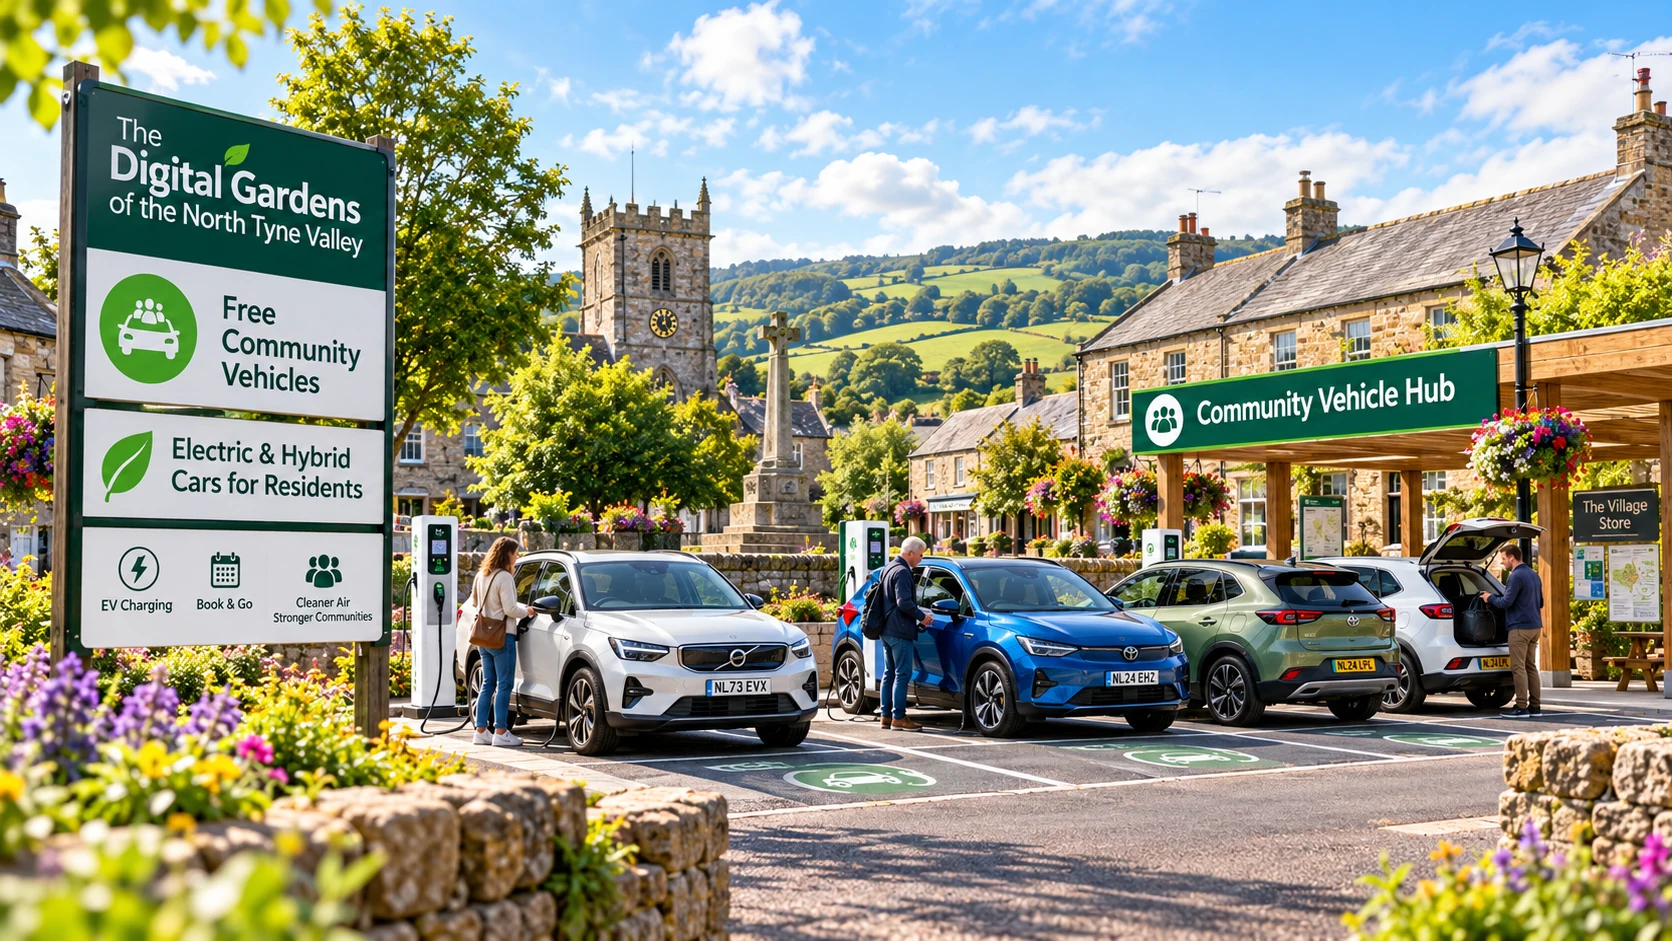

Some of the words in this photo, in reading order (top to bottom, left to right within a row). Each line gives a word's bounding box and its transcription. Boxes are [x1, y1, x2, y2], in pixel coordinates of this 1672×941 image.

[117, 116, 162, 147] The
[110, 144, 222, 198] Digital
[231, 170, 361, 224] Gardens
[109, 192, 134, 216] of
[139, 197, 177, 222] the
[183, 202, 246, 235] North
[251, 214, 300, 244] Tyne
[305, 224, 363, 258] Valley
[222, 294, 276, 325] Free
[221, 328, 361, 372] Community
[221, 361, 320, 393] Vehicles
[1196, 391, 1313, 425] Community
[1318, 380, 1399, 413] Vehicle
[1405, 373, 1456, 405] Hub
[172, 437, 253, 463] Electric
[259, 442, 275, 465] &
[281, 444, 351, 472] Hybrid
[171, 469, 221, 494] Cars
[227, 471, 259, 495] for
[264, 474, 363, 499] Residents
[1583, 500, 1605, 513] The
[1607, 498, 1648, 515] Village
[1599, 516, 1631, 530] Store
[101, 599, 118, 612] EV
[120, 598, 173, 614] Charging
[196, 598, 224, 610] Book
[226, 598, 235, 610] &
[237, 598, 253, 610] Go
[296, 596, 334, 608] Cleaner
[336, 597, 351, 608] Air
[273, 612, 314, 625] Stronger
[315, 610, 373, 623] Communities
[714, 681, 743, 693] NL73
[746, 680, 767, 692] EVX
[1112, 672, 1136, 684] NL24
